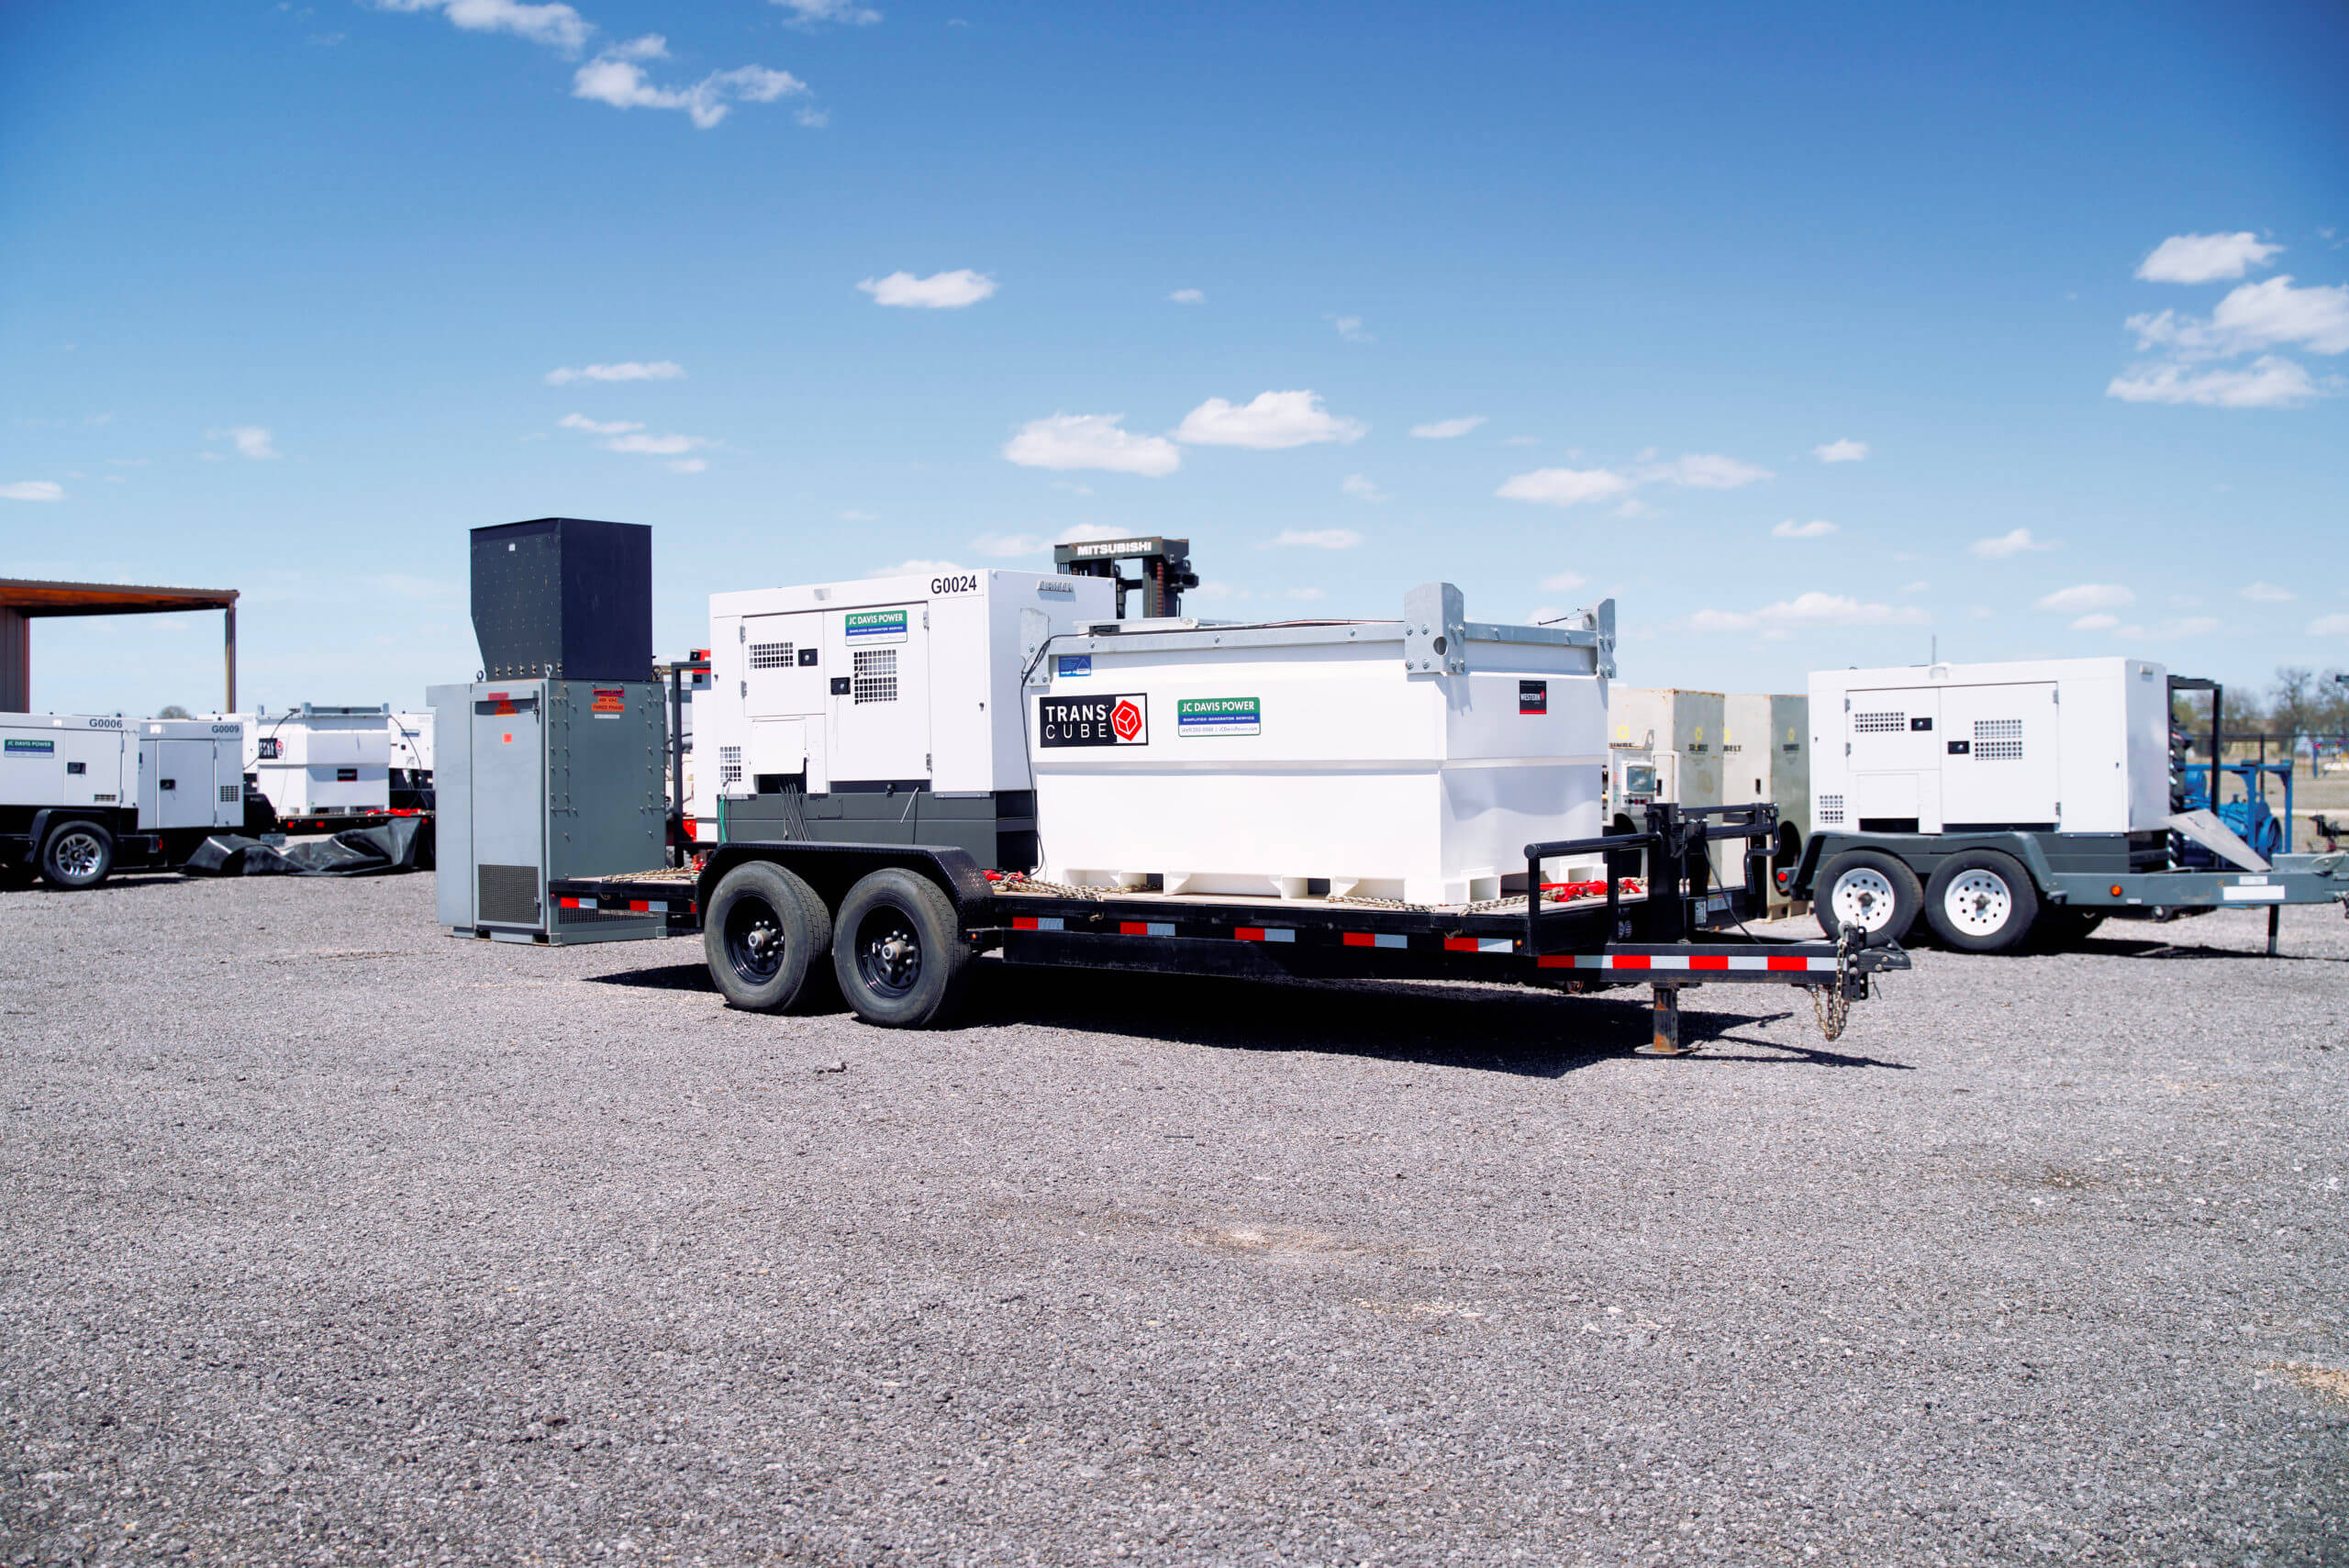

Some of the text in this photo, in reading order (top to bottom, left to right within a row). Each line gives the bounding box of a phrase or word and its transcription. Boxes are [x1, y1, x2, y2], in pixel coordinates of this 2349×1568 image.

[1077, 540, 1152, 556] MITSUBISHI
[930, 574, 977, 595] G0024
[849, 613, 904, 626] JC DAVIS POWER
[1045, 704, 1107, 722] TRANS
[1182, 701, 1255, 712] JC DAVIS POWER
[89, 718, 123, 728] G0006
[211, 725, 239, 733] G0009
[1045, 723, 1108, 740] CUBE
